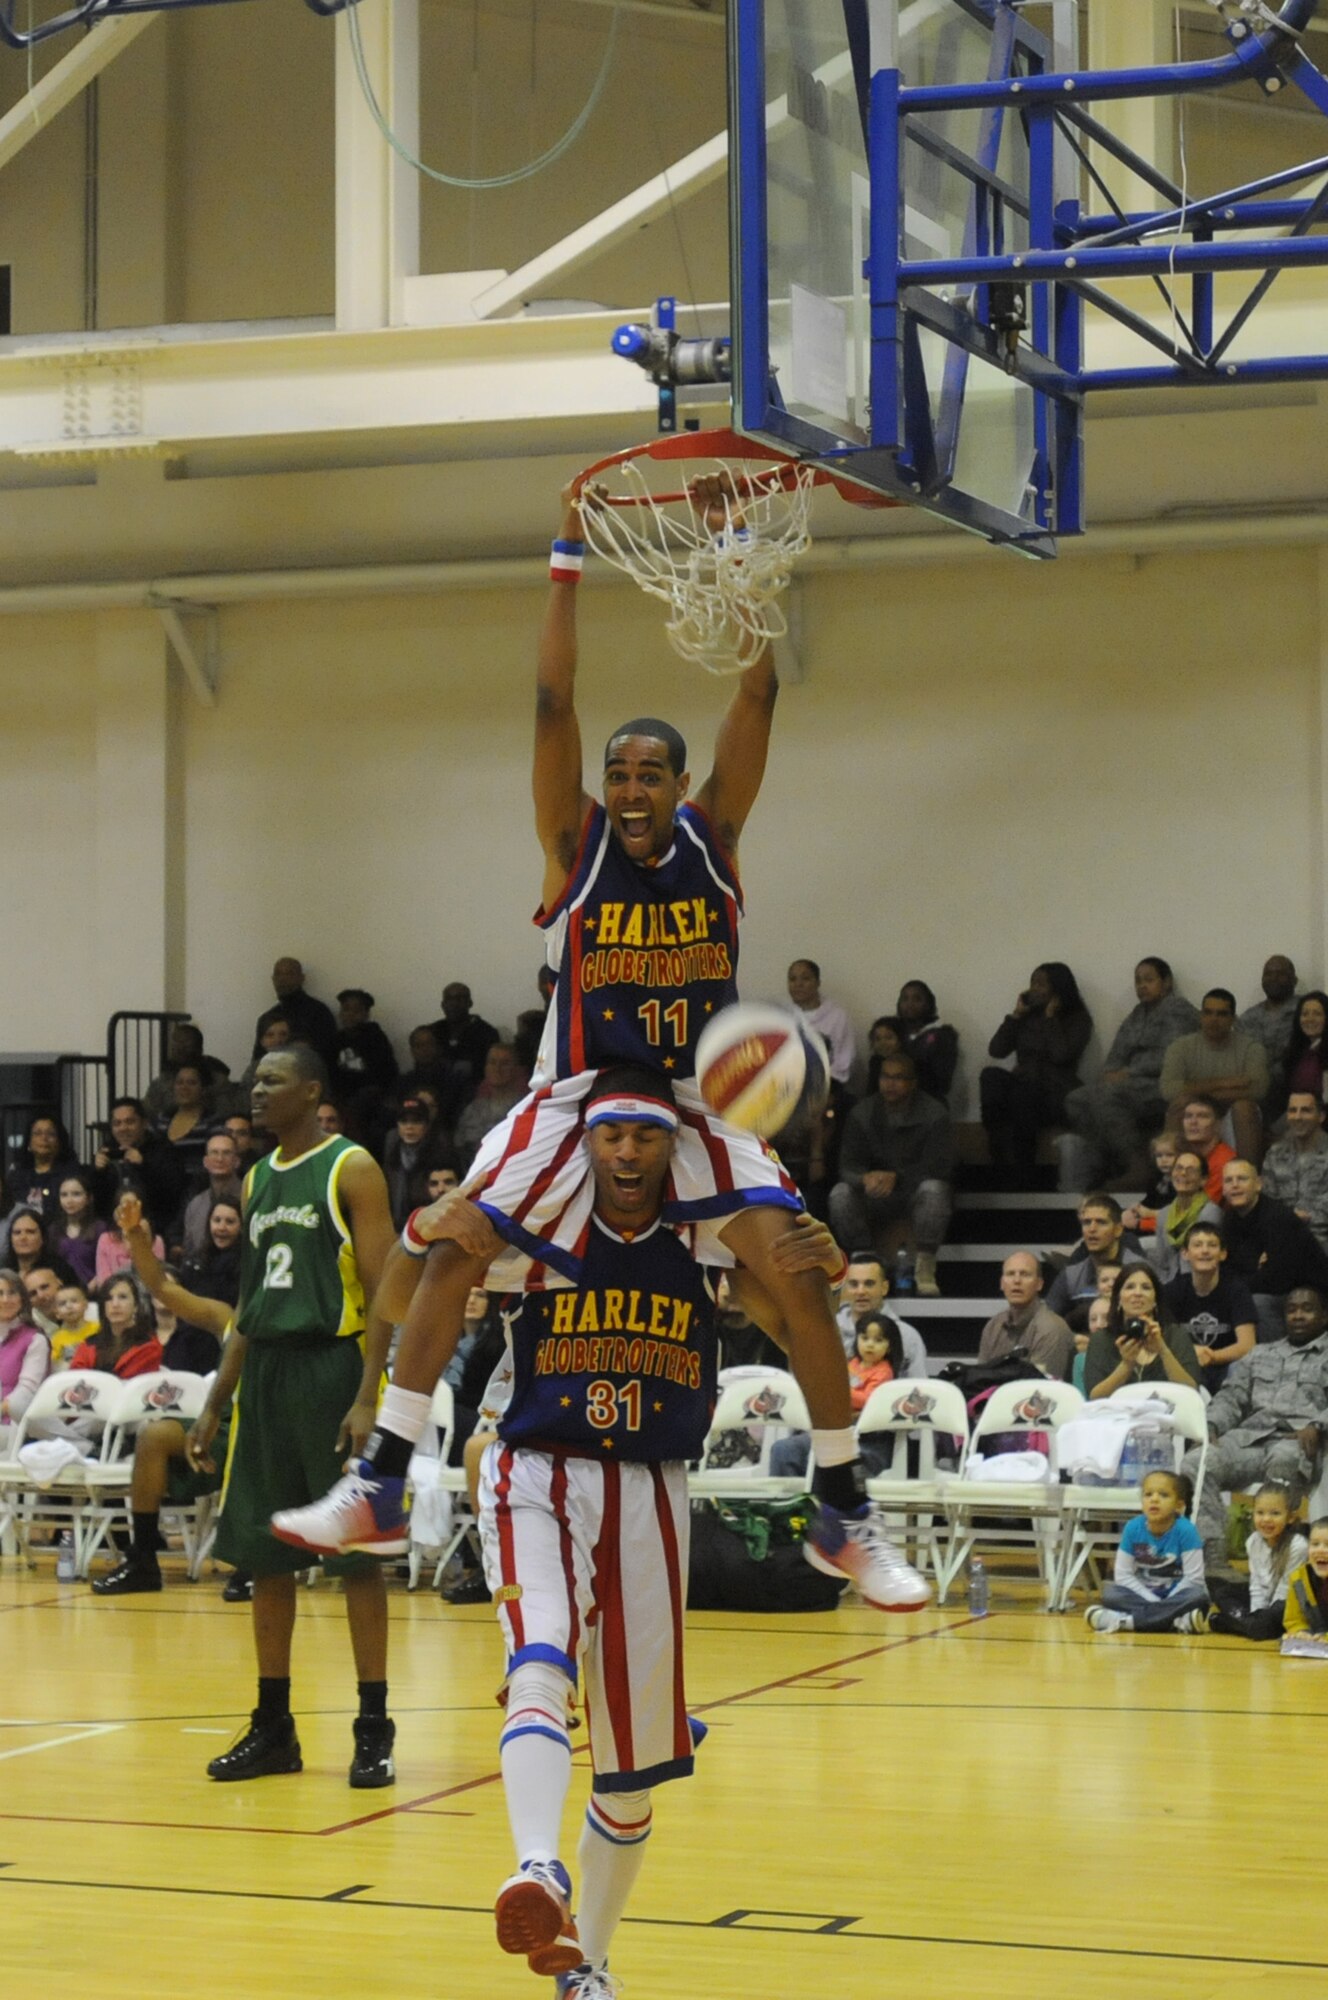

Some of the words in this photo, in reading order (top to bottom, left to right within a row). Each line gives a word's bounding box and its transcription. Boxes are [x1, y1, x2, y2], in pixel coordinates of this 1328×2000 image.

[596, 897, 709, 946] HARLEM
[581, 942, 732, 993] GLOBETROTTERS
[637, 998, 688, 1047] 11
[552, 1288, 693, 1342] HARLEM
[535, 1336, 701, 1390] GLOBETROTTERS
[586, 1379, 641, 1432] 31
